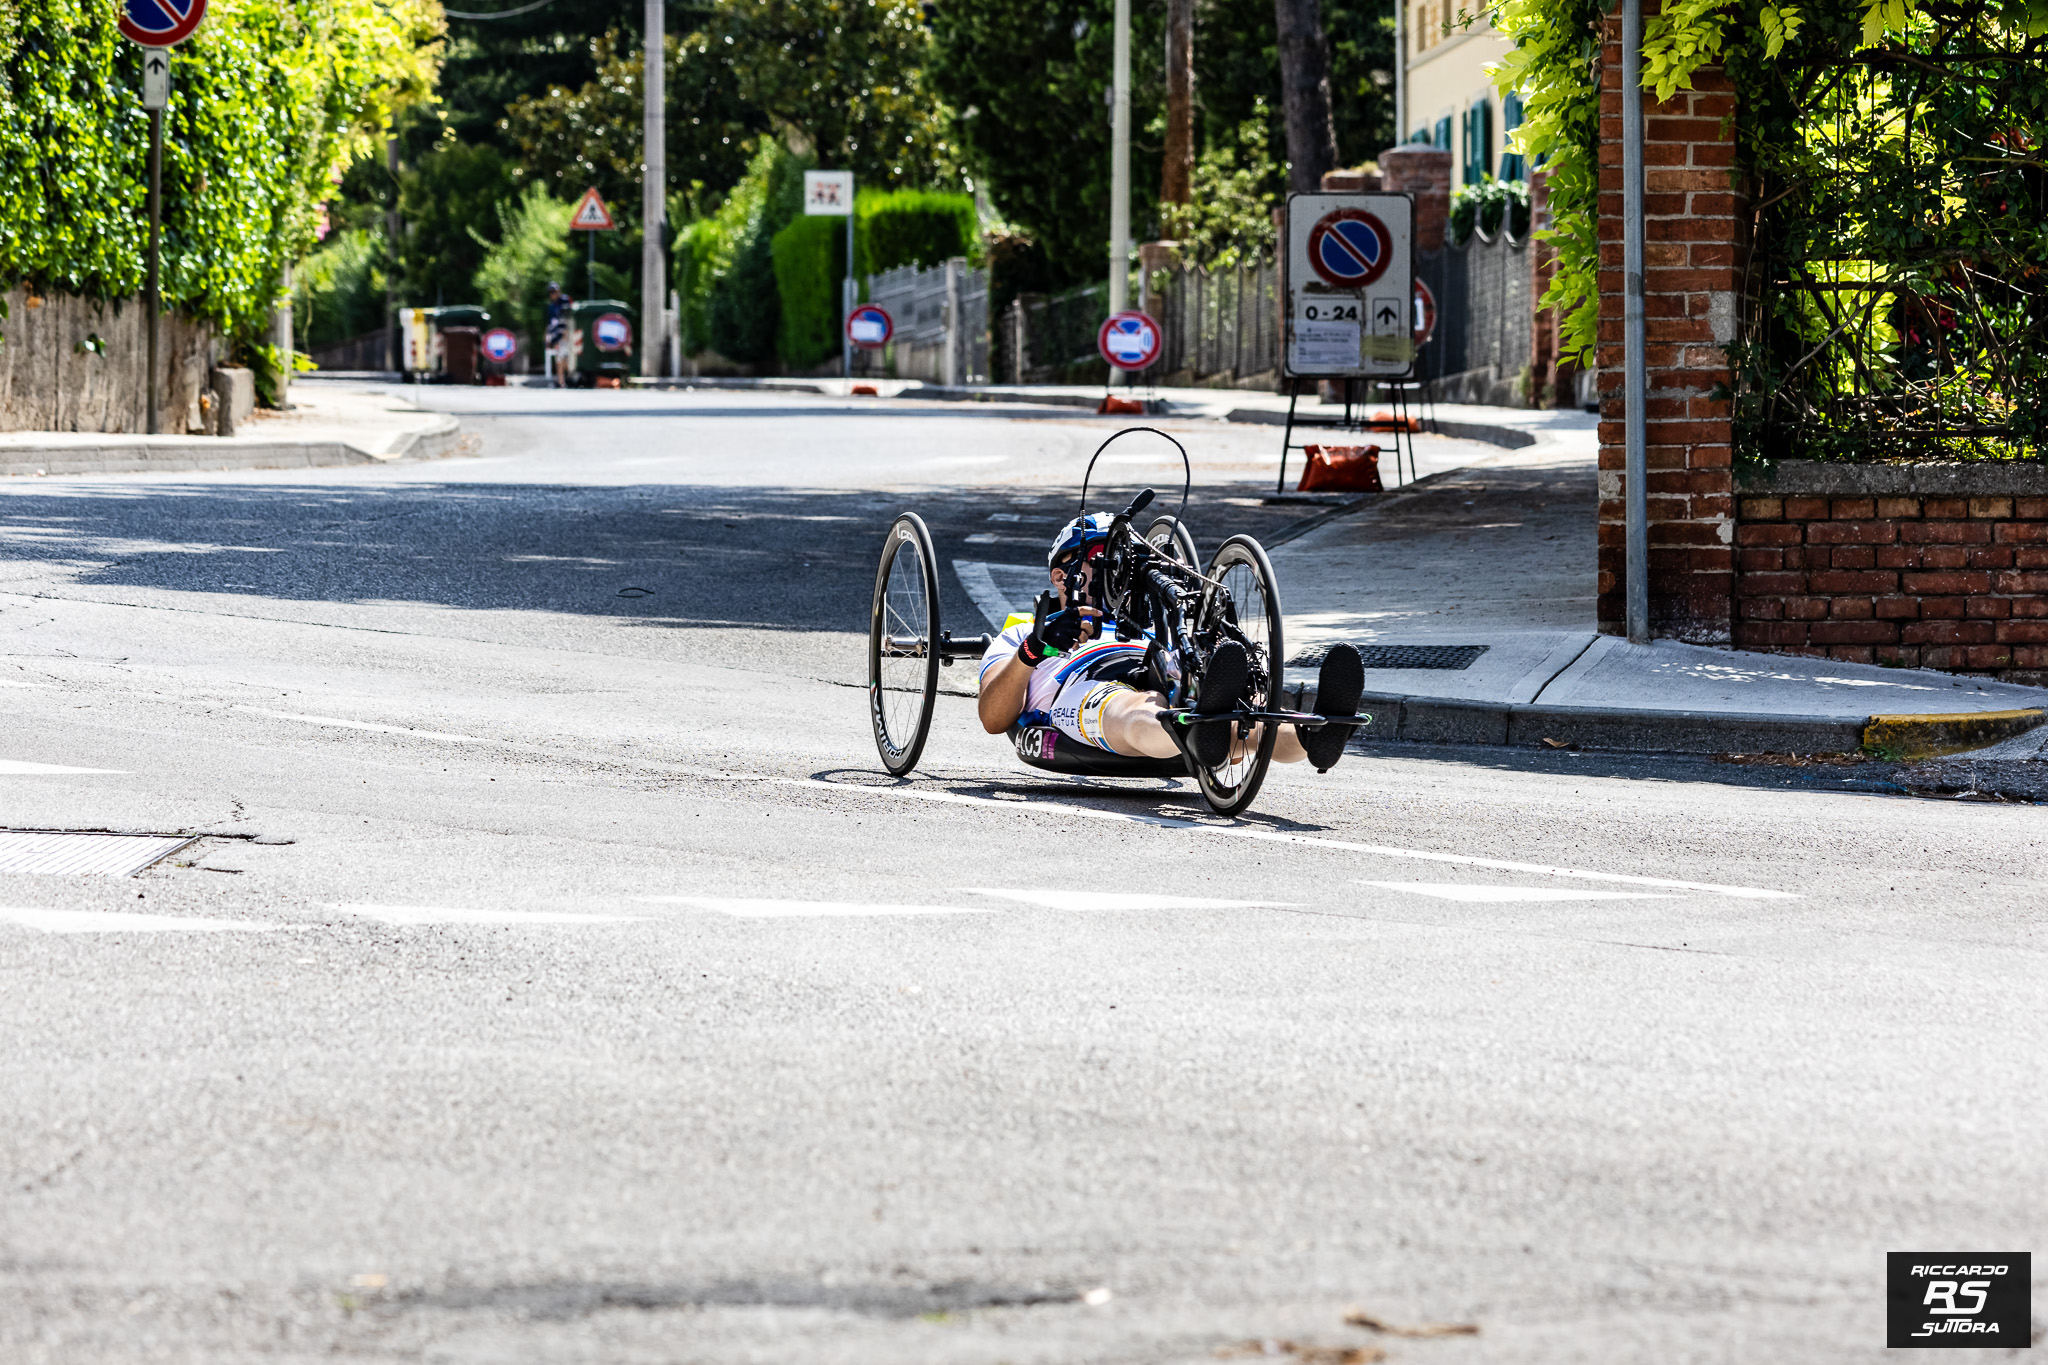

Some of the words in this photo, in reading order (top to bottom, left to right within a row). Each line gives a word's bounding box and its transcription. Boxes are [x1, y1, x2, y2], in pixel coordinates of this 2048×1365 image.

[1305, 305, 1318, 320] 0
[1333, 305, 1357, 320] 24
[1052, 707, 1076, 718] REALE
